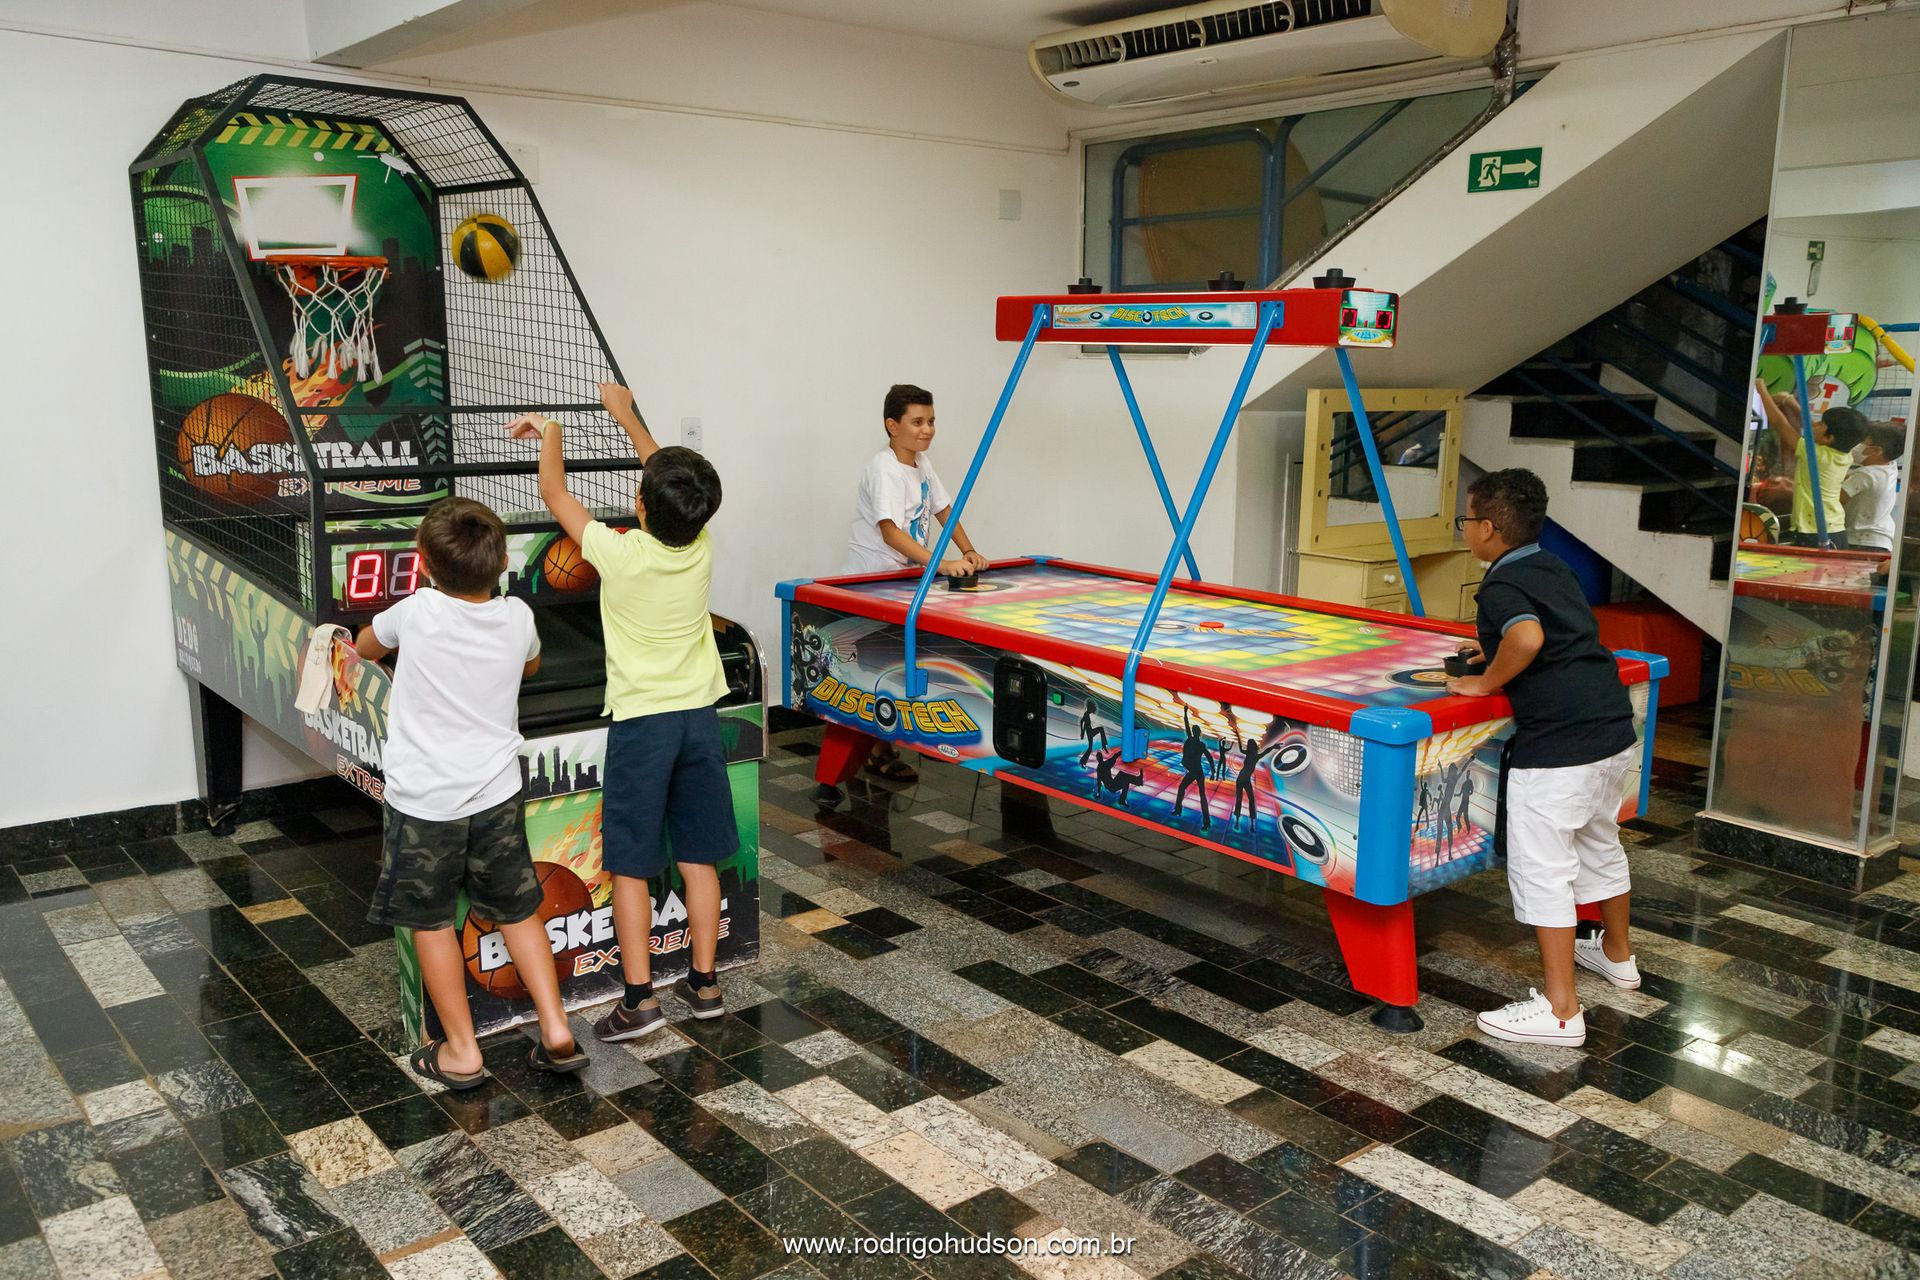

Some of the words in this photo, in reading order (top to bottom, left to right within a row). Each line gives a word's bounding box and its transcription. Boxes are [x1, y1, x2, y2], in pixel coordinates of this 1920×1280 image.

[810, 675, 979, 735] DISCOTECH
[304, 707, 386, 772] BASKETBA
[336, 753, 385, 804] EXTRE
[573, 917, 732, 977] EXREE
